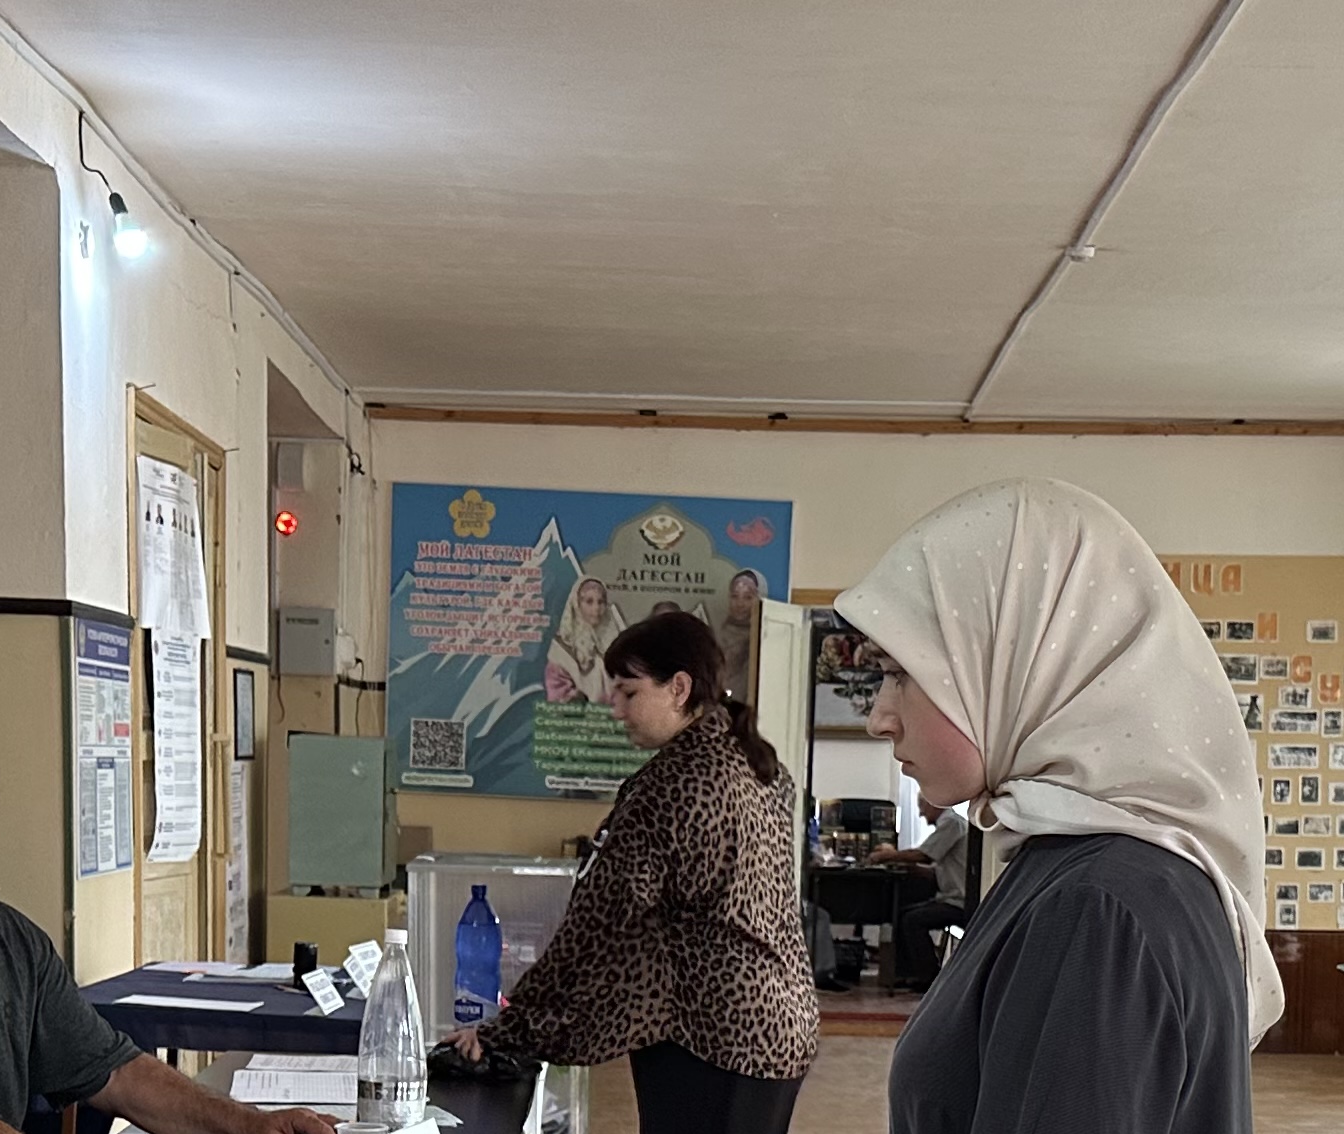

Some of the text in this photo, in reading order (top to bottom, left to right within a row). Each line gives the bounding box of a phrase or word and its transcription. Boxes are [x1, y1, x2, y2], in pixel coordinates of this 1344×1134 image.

[418, 541, 450, 558] МОЙ
[642, 551, 681, 567] МОЙ
[616, 567, 706, 585] ДАГЕСТАН
